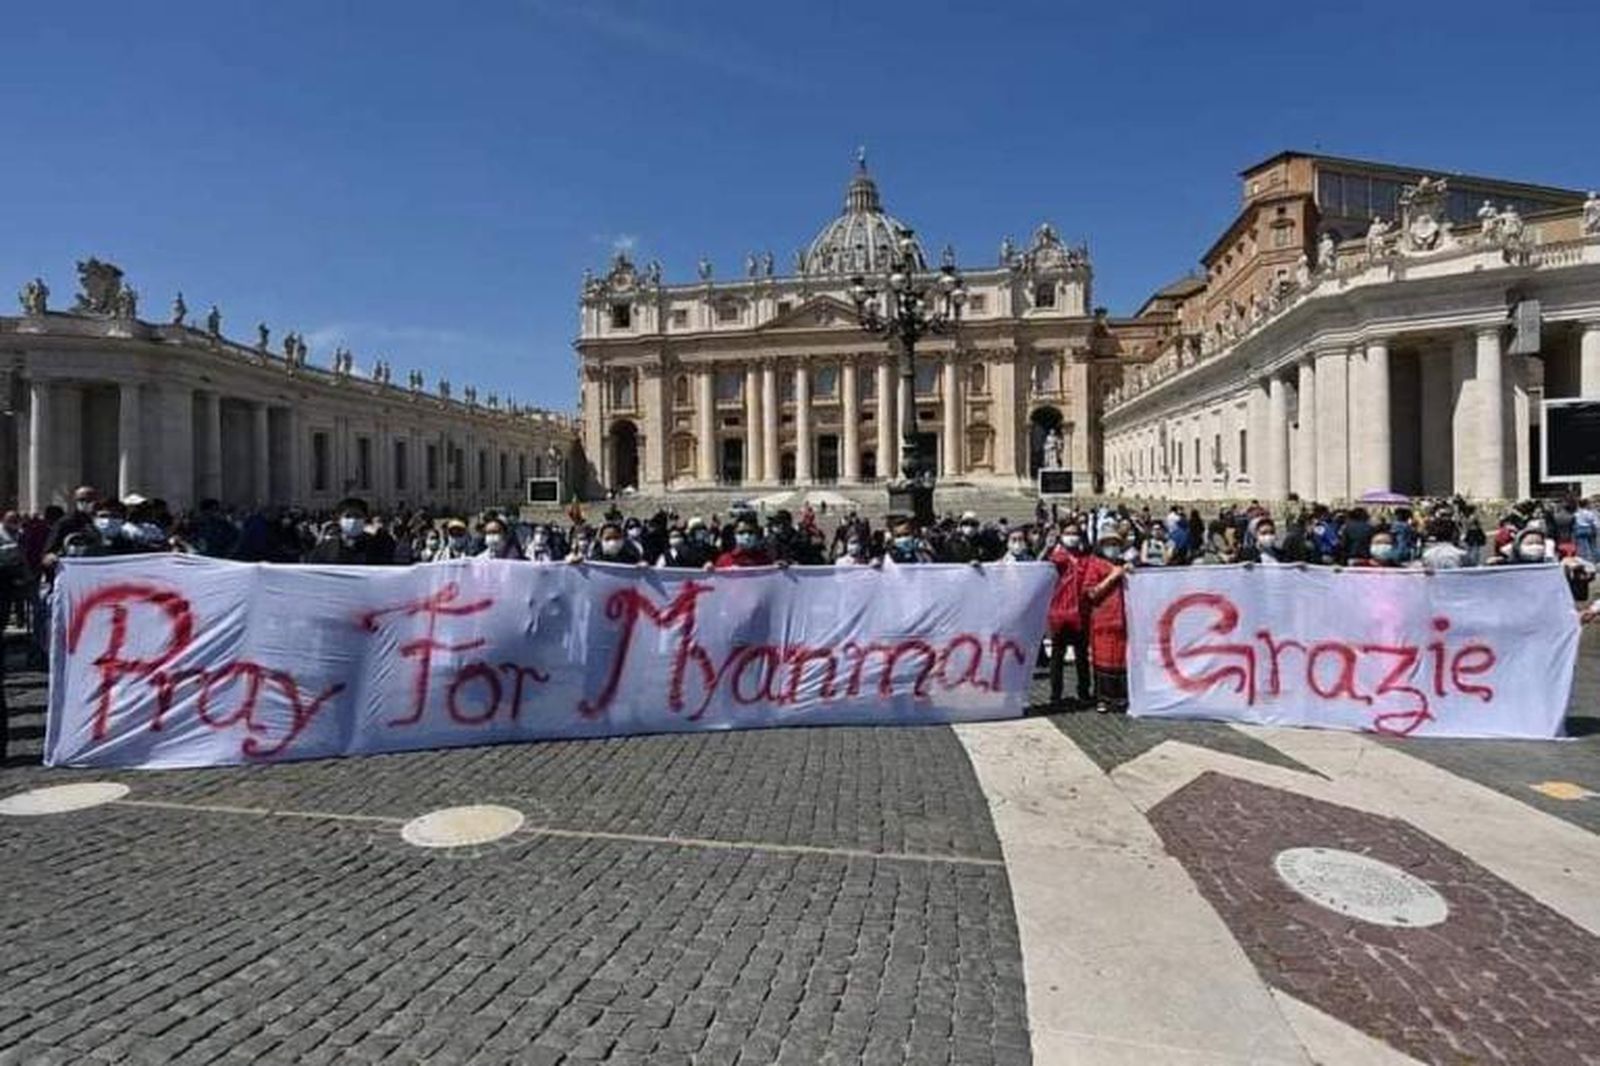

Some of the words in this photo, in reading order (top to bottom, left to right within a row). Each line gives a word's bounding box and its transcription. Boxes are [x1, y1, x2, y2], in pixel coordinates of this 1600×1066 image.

[67, 582, 346, 759] Pray
[354, 581, 550, 728] For
[578, 581, 1026, 721] Myanmar
[1157, 592, 1497, 736] Grazie
